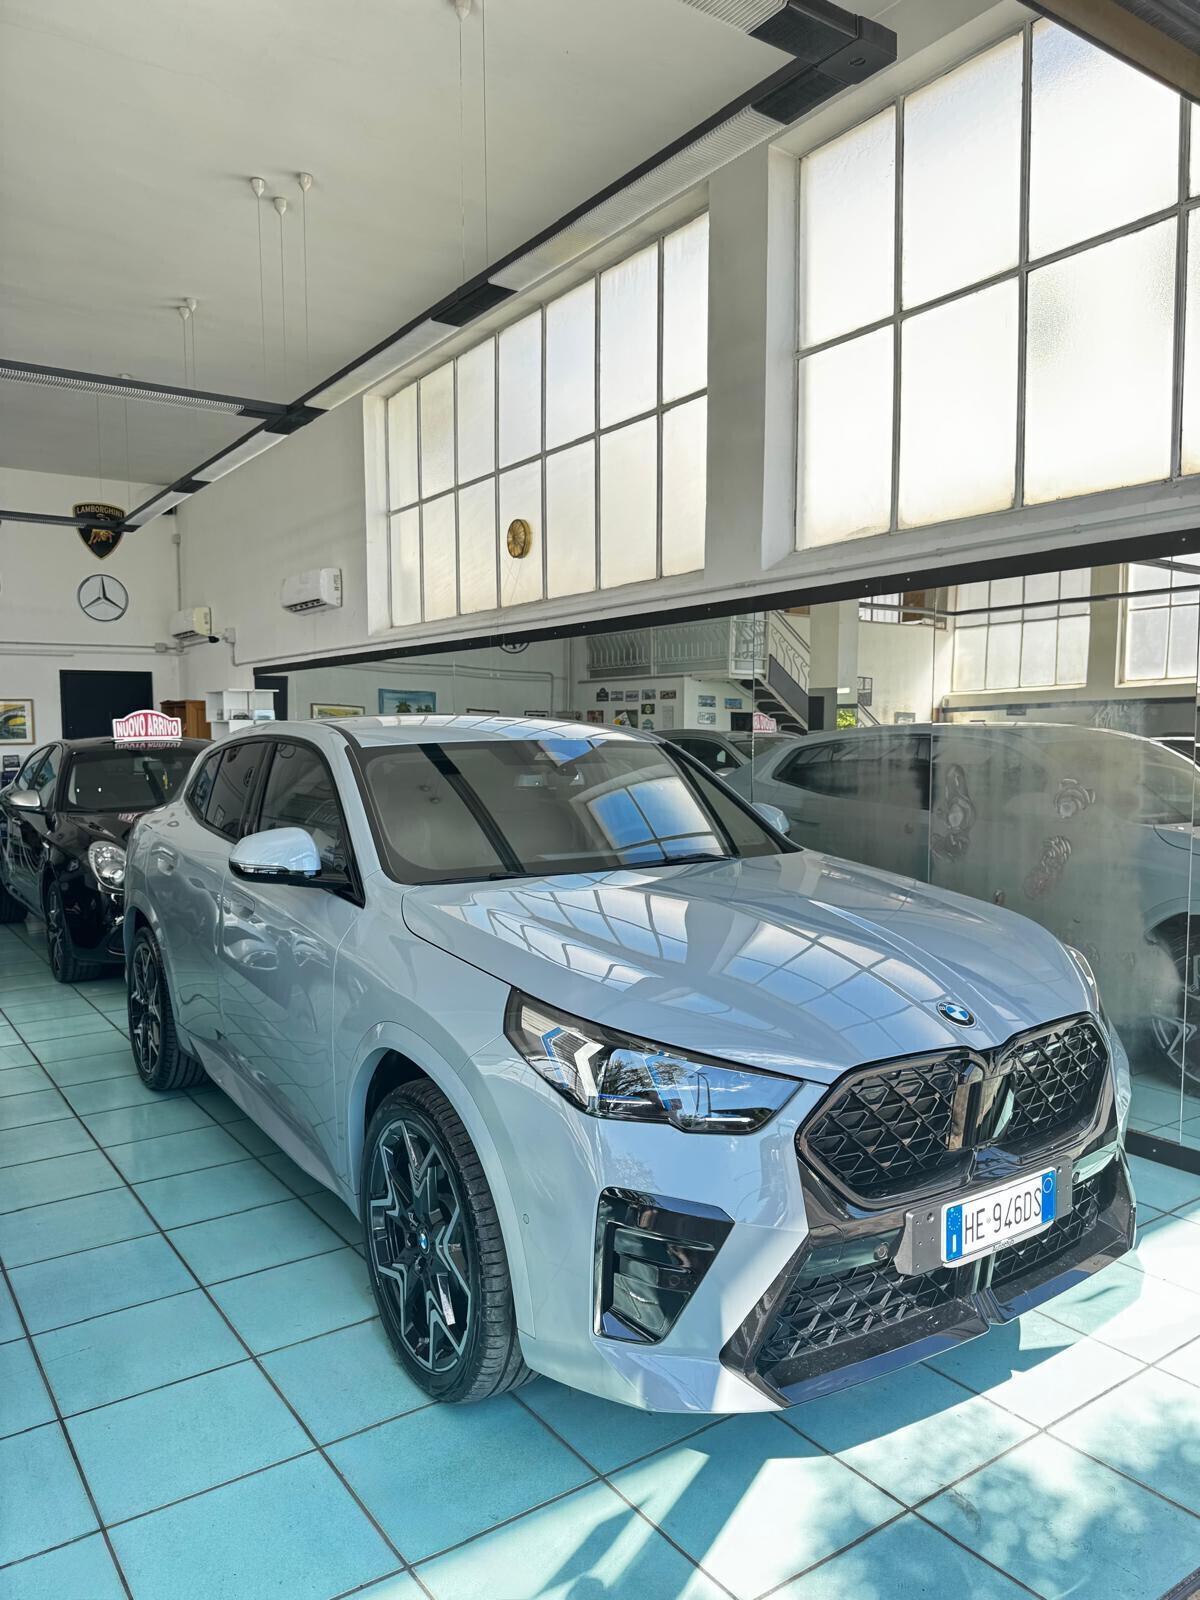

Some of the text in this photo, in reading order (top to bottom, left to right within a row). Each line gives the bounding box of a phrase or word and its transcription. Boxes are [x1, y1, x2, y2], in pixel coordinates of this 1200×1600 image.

[76, 505, 124, 518] LAMBORGHINI
[116, 714, 178, 737] NUOVO ARRIVO
[965, 1187, 1042, 1245] HE 946DS
